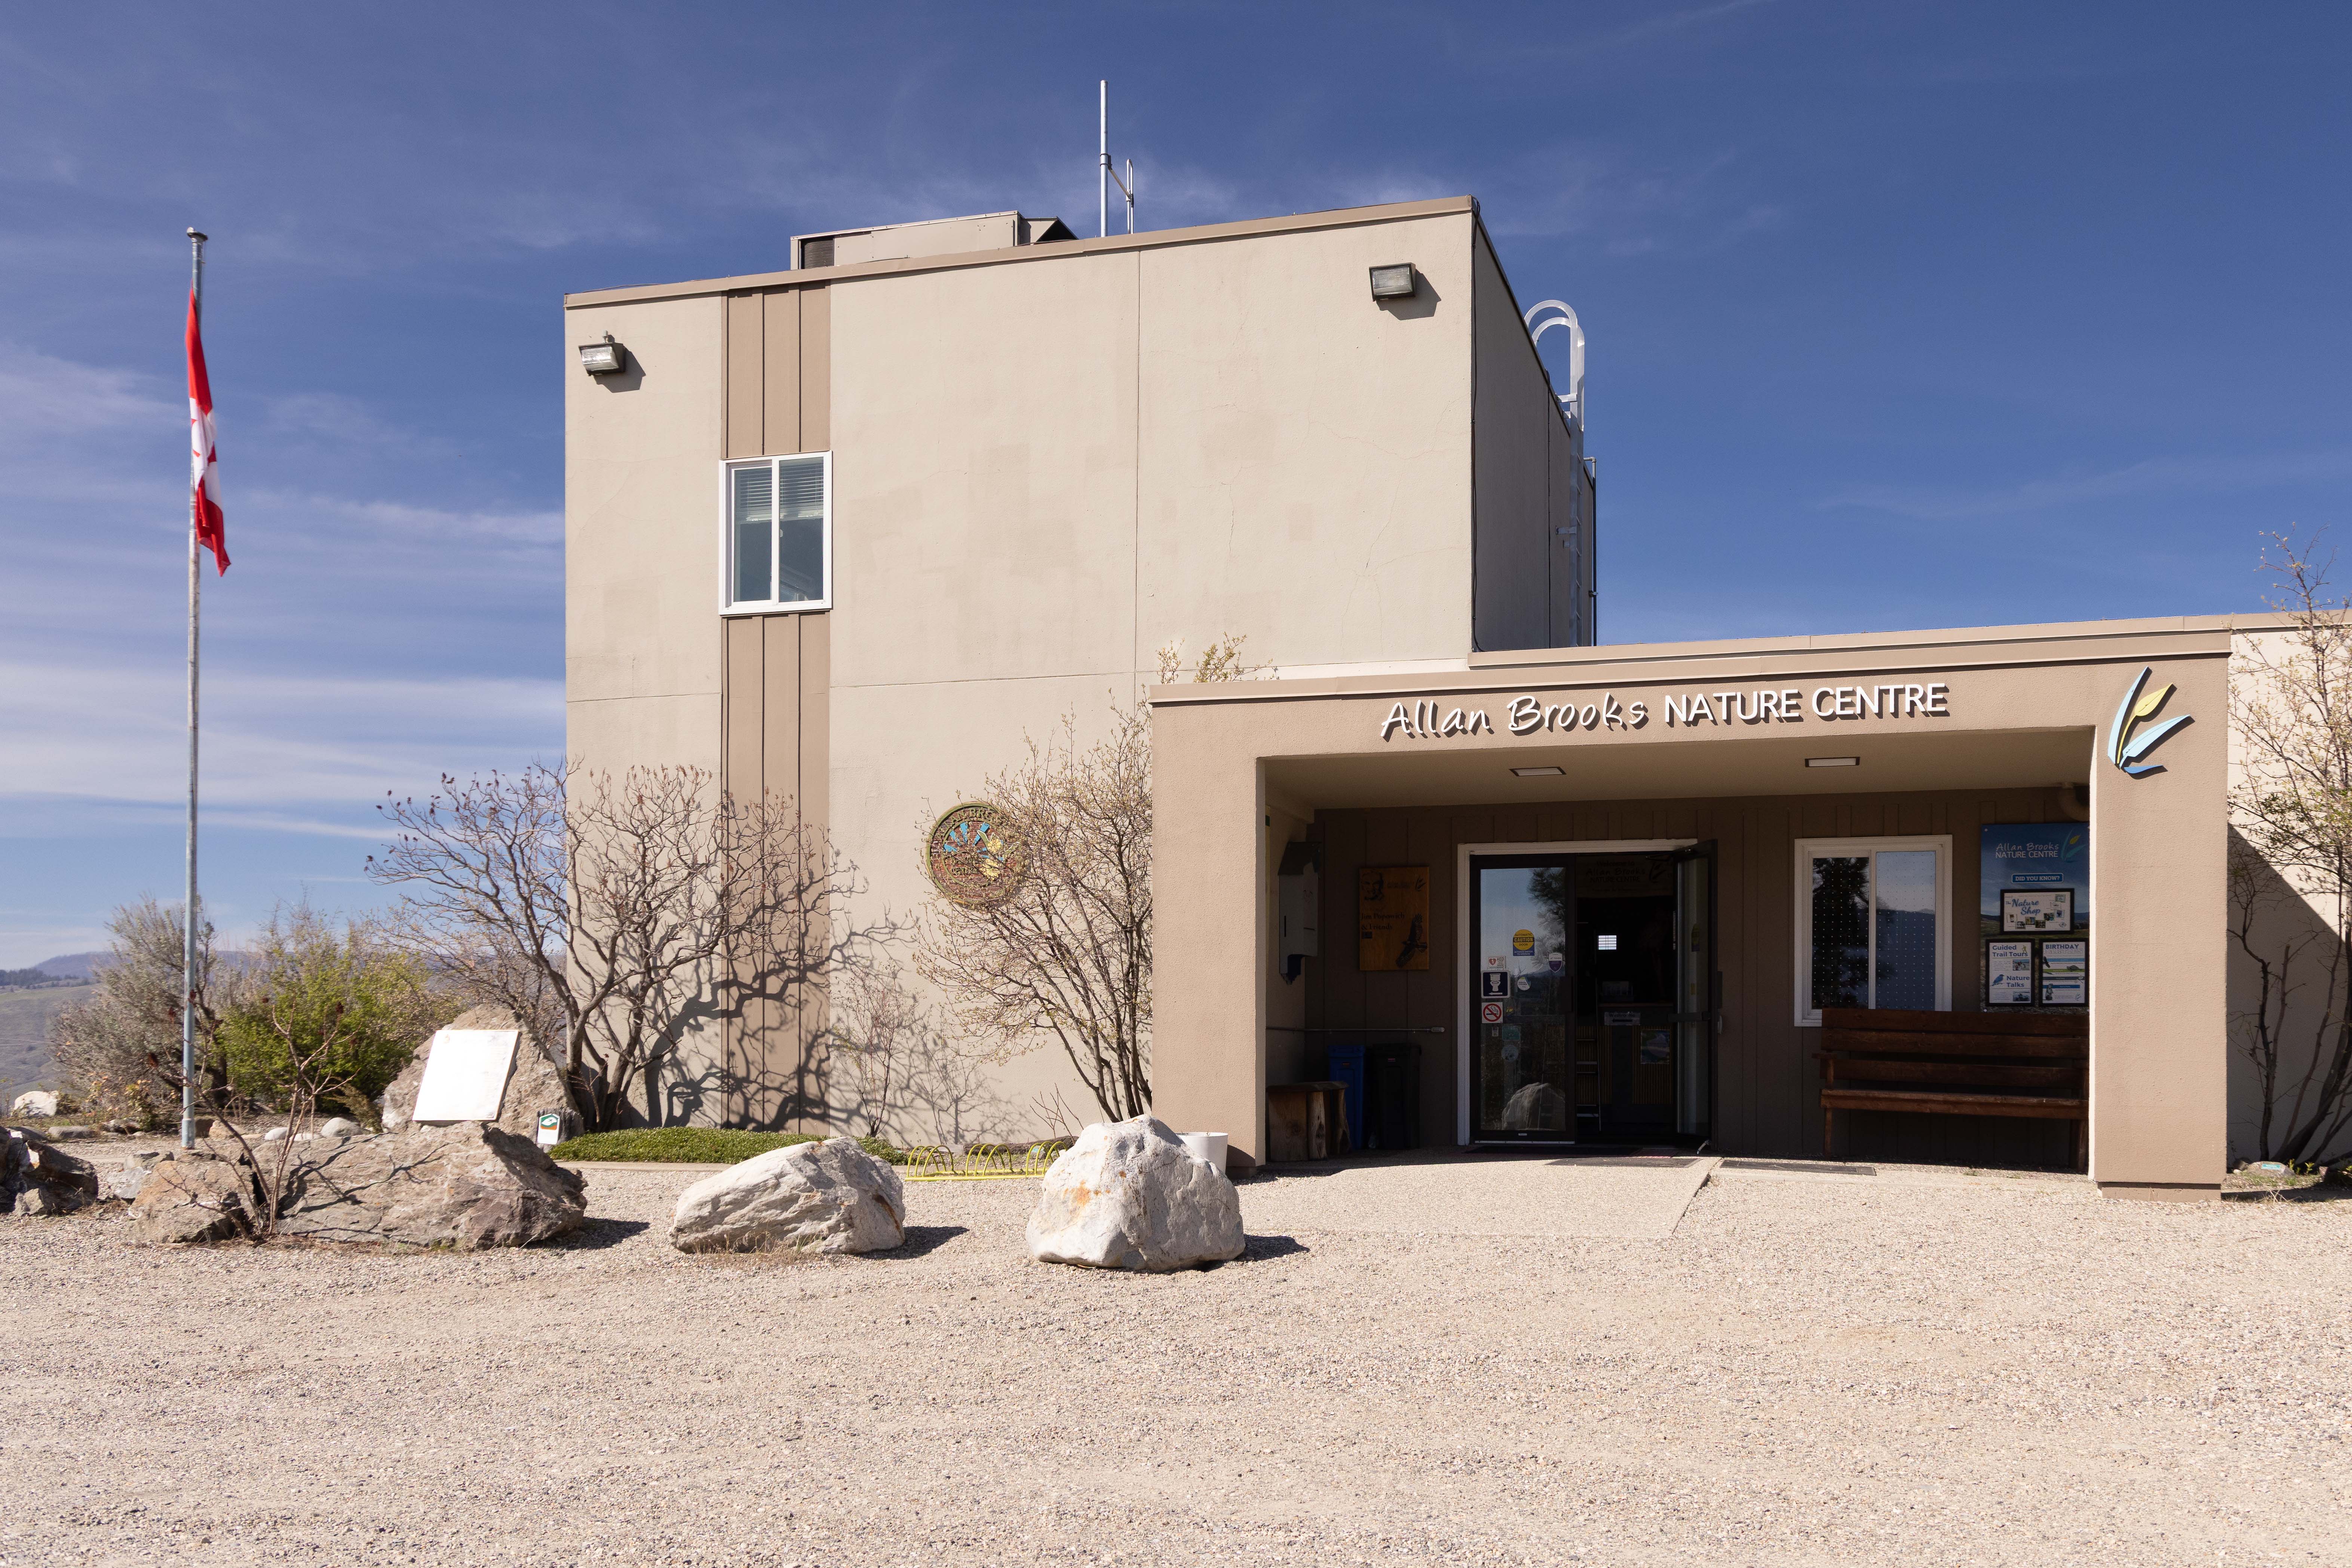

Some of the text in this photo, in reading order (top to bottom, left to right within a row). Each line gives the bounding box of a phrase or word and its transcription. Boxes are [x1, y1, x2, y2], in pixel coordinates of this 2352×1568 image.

[1380, 683, 1946, 737] Allan Brooks NATURE CENTRE
[1996, 842, 2059, 851] Allan Brooks
[1586, 867, 1645, 877] Allan Brooks
[2012, 899, 2039, 907] Nature
[2021, 906, 2040, 916] Shop
